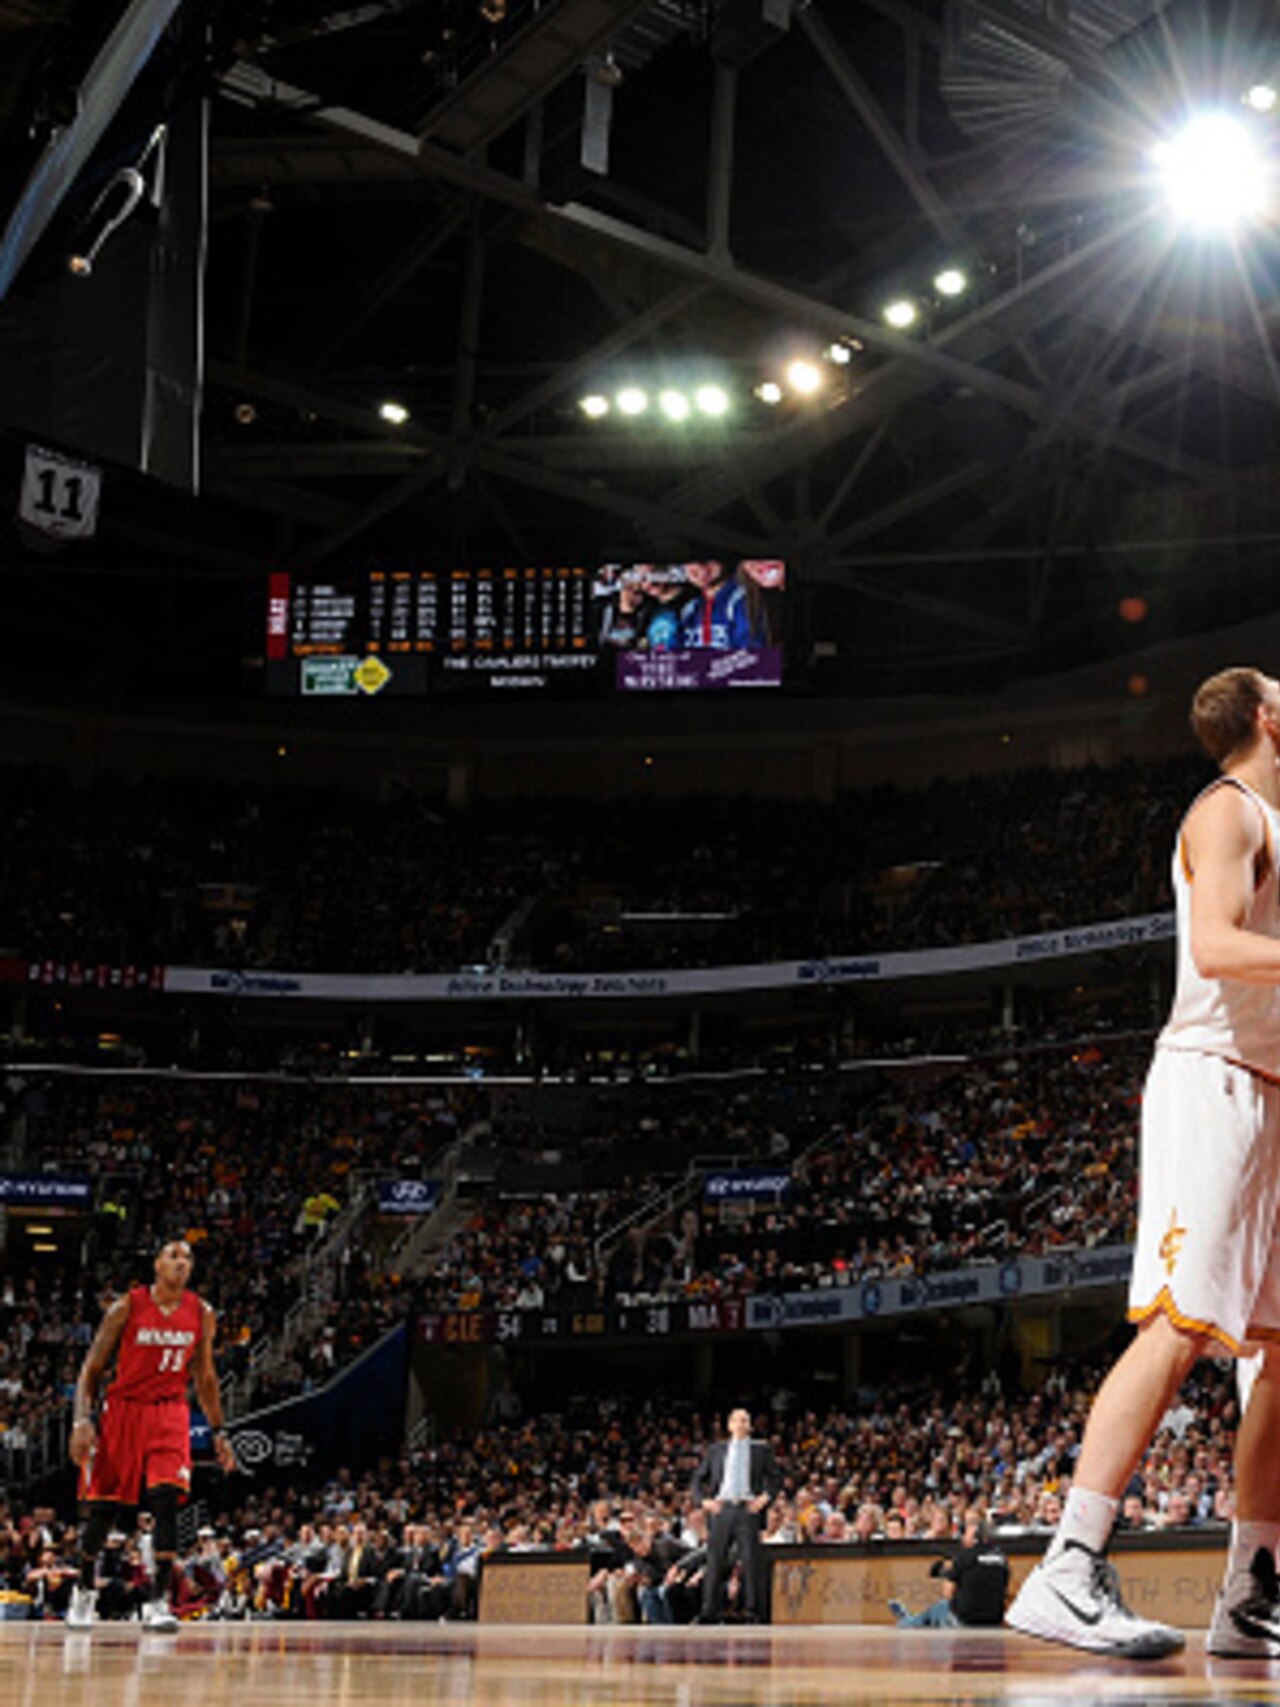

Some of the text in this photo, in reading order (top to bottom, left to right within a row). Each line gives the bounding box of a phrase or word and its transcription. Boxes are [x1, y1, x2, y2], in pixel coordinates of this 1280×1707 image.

[34, 468, 83, 522] 11
[446, 1314, 484, 1342] CLE
[687, 1303, 720, 1330] MIA
